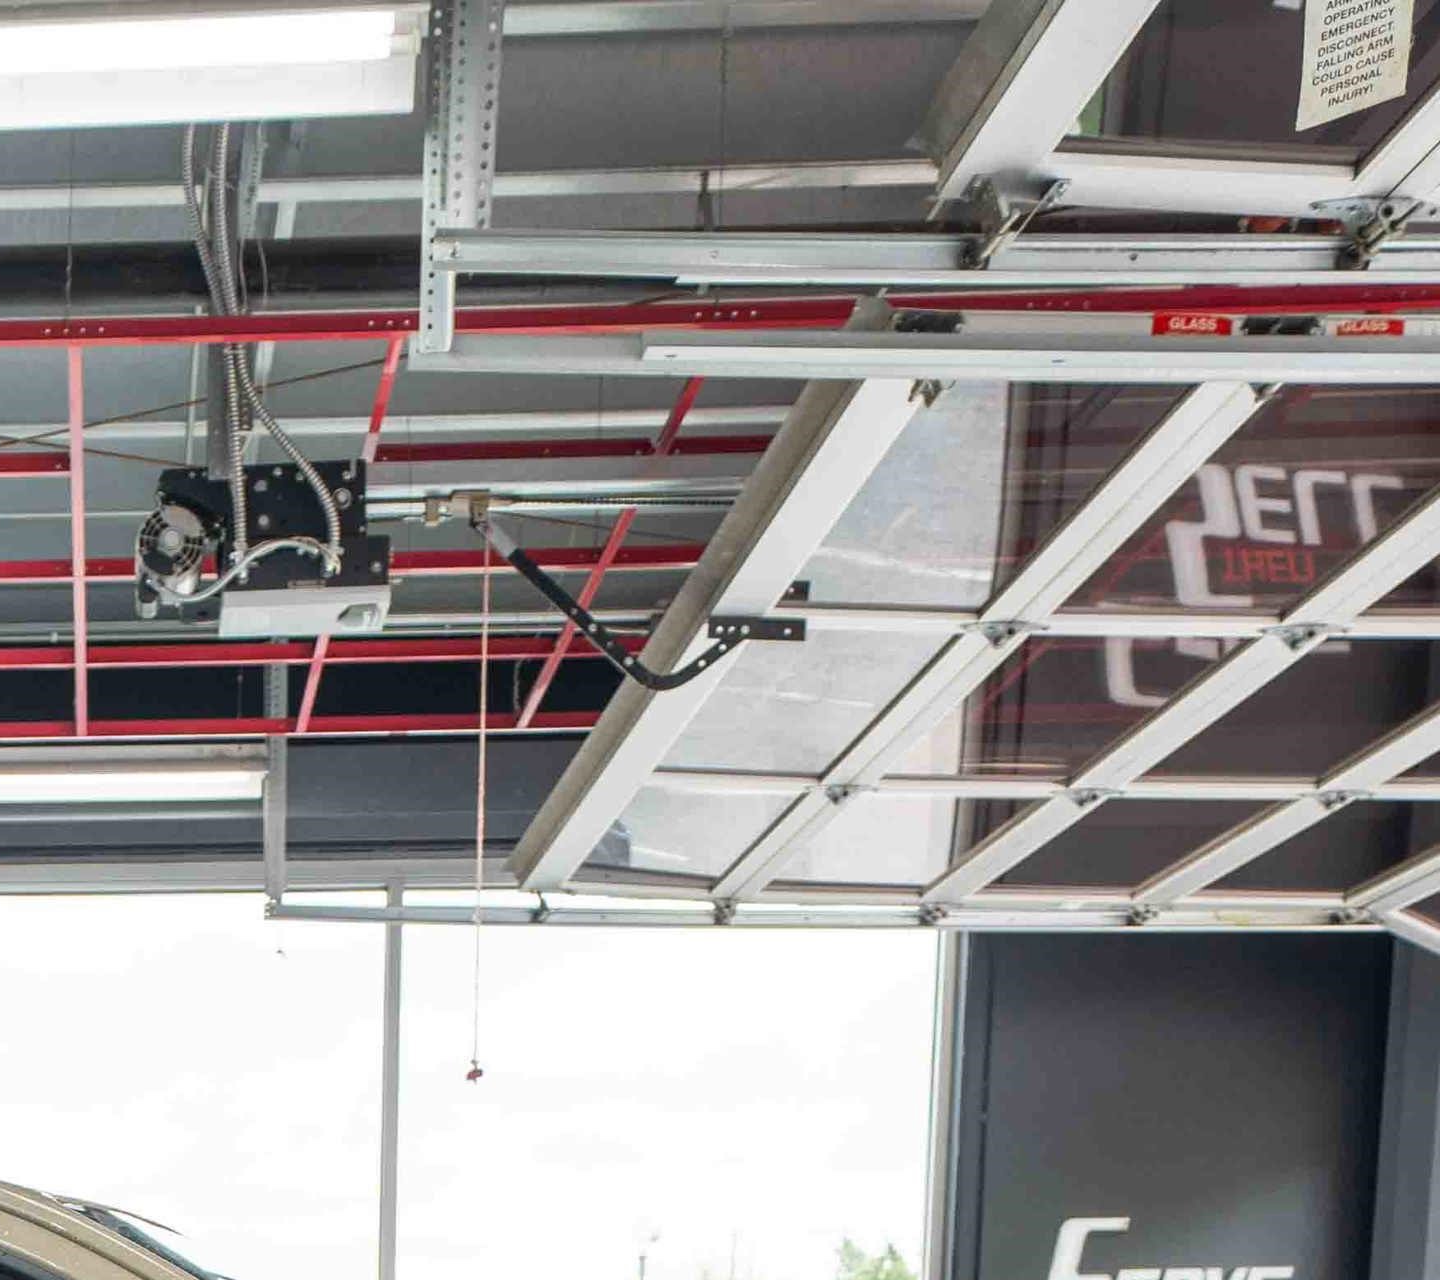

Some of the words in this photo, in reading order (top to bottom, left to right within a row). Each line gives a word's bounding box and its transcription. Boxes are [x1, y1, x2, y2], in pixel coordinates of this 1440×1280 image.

[1321, 7, 1395, 41] EMERGENCY
[1311, 64, 1353, 87] COULD
[1355, 48, 1396, 71] CAUSE
[1316, 46, 1364, 72] FALLING
[1367, 34, 1394, 53] ARM
[1319, 67, 1383, 97] PERSONAL
[1327, 84, 1374, 108] INJURY!
[1169, 317, 1218, 331] GLASS
[1342, 319, 1391, 333] GLASS
